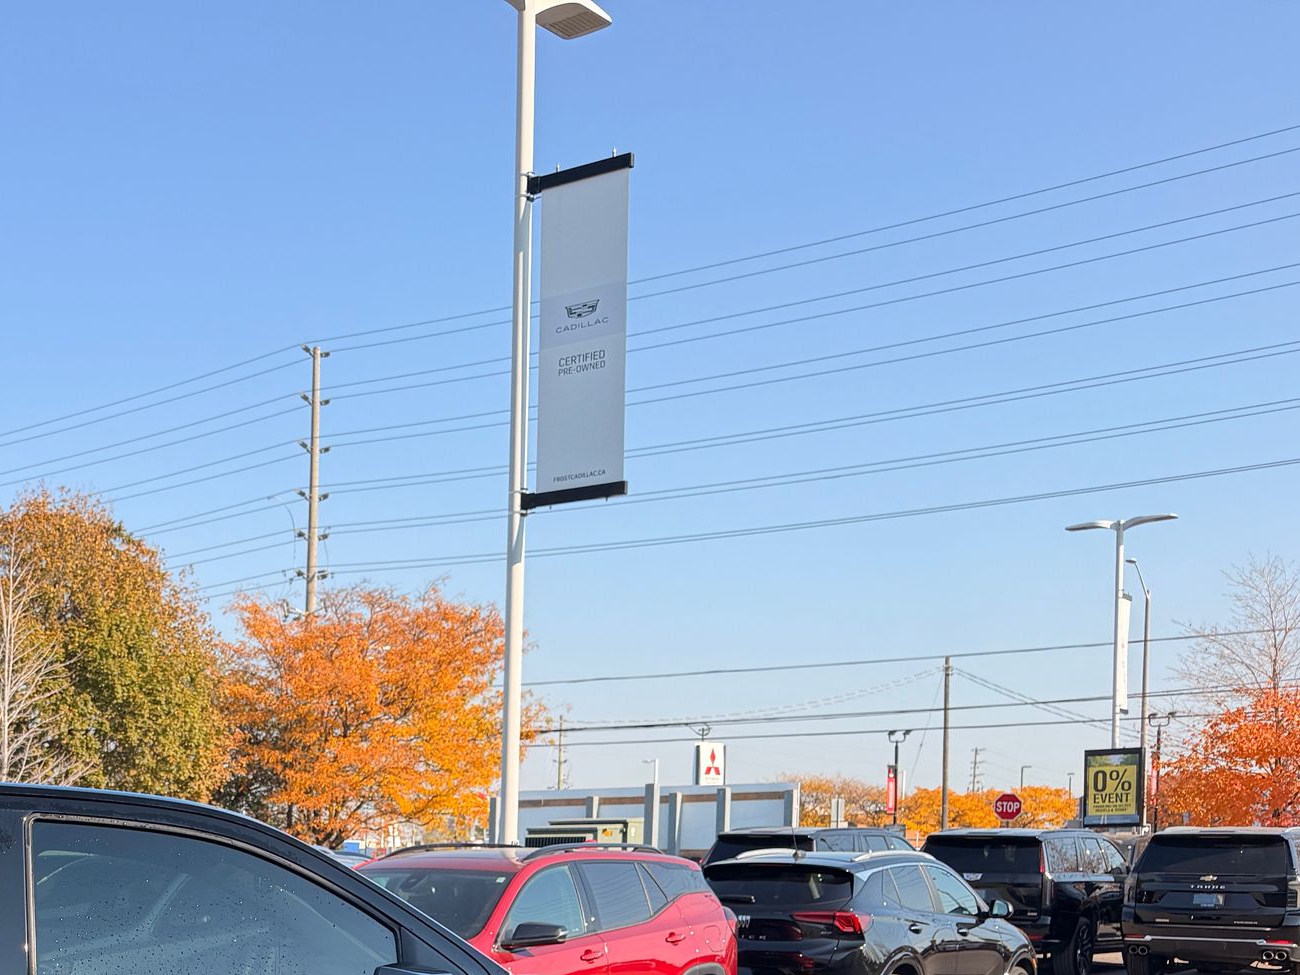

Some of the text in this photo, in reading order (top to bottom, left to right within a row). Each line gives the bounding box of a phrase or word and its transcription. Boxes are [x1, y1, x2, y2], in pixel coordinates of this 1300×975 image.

[555, 316, 609, 334] CADILLAC
[558, 349, 606, 368] CERTIFIED
[558, 360, 606, 376] PRE-OWNED
[1093, 768, 1132, 793] 0%
[996, 801, 1020, 812] STOP
[1093, 792, 1131, 804] EVENT
